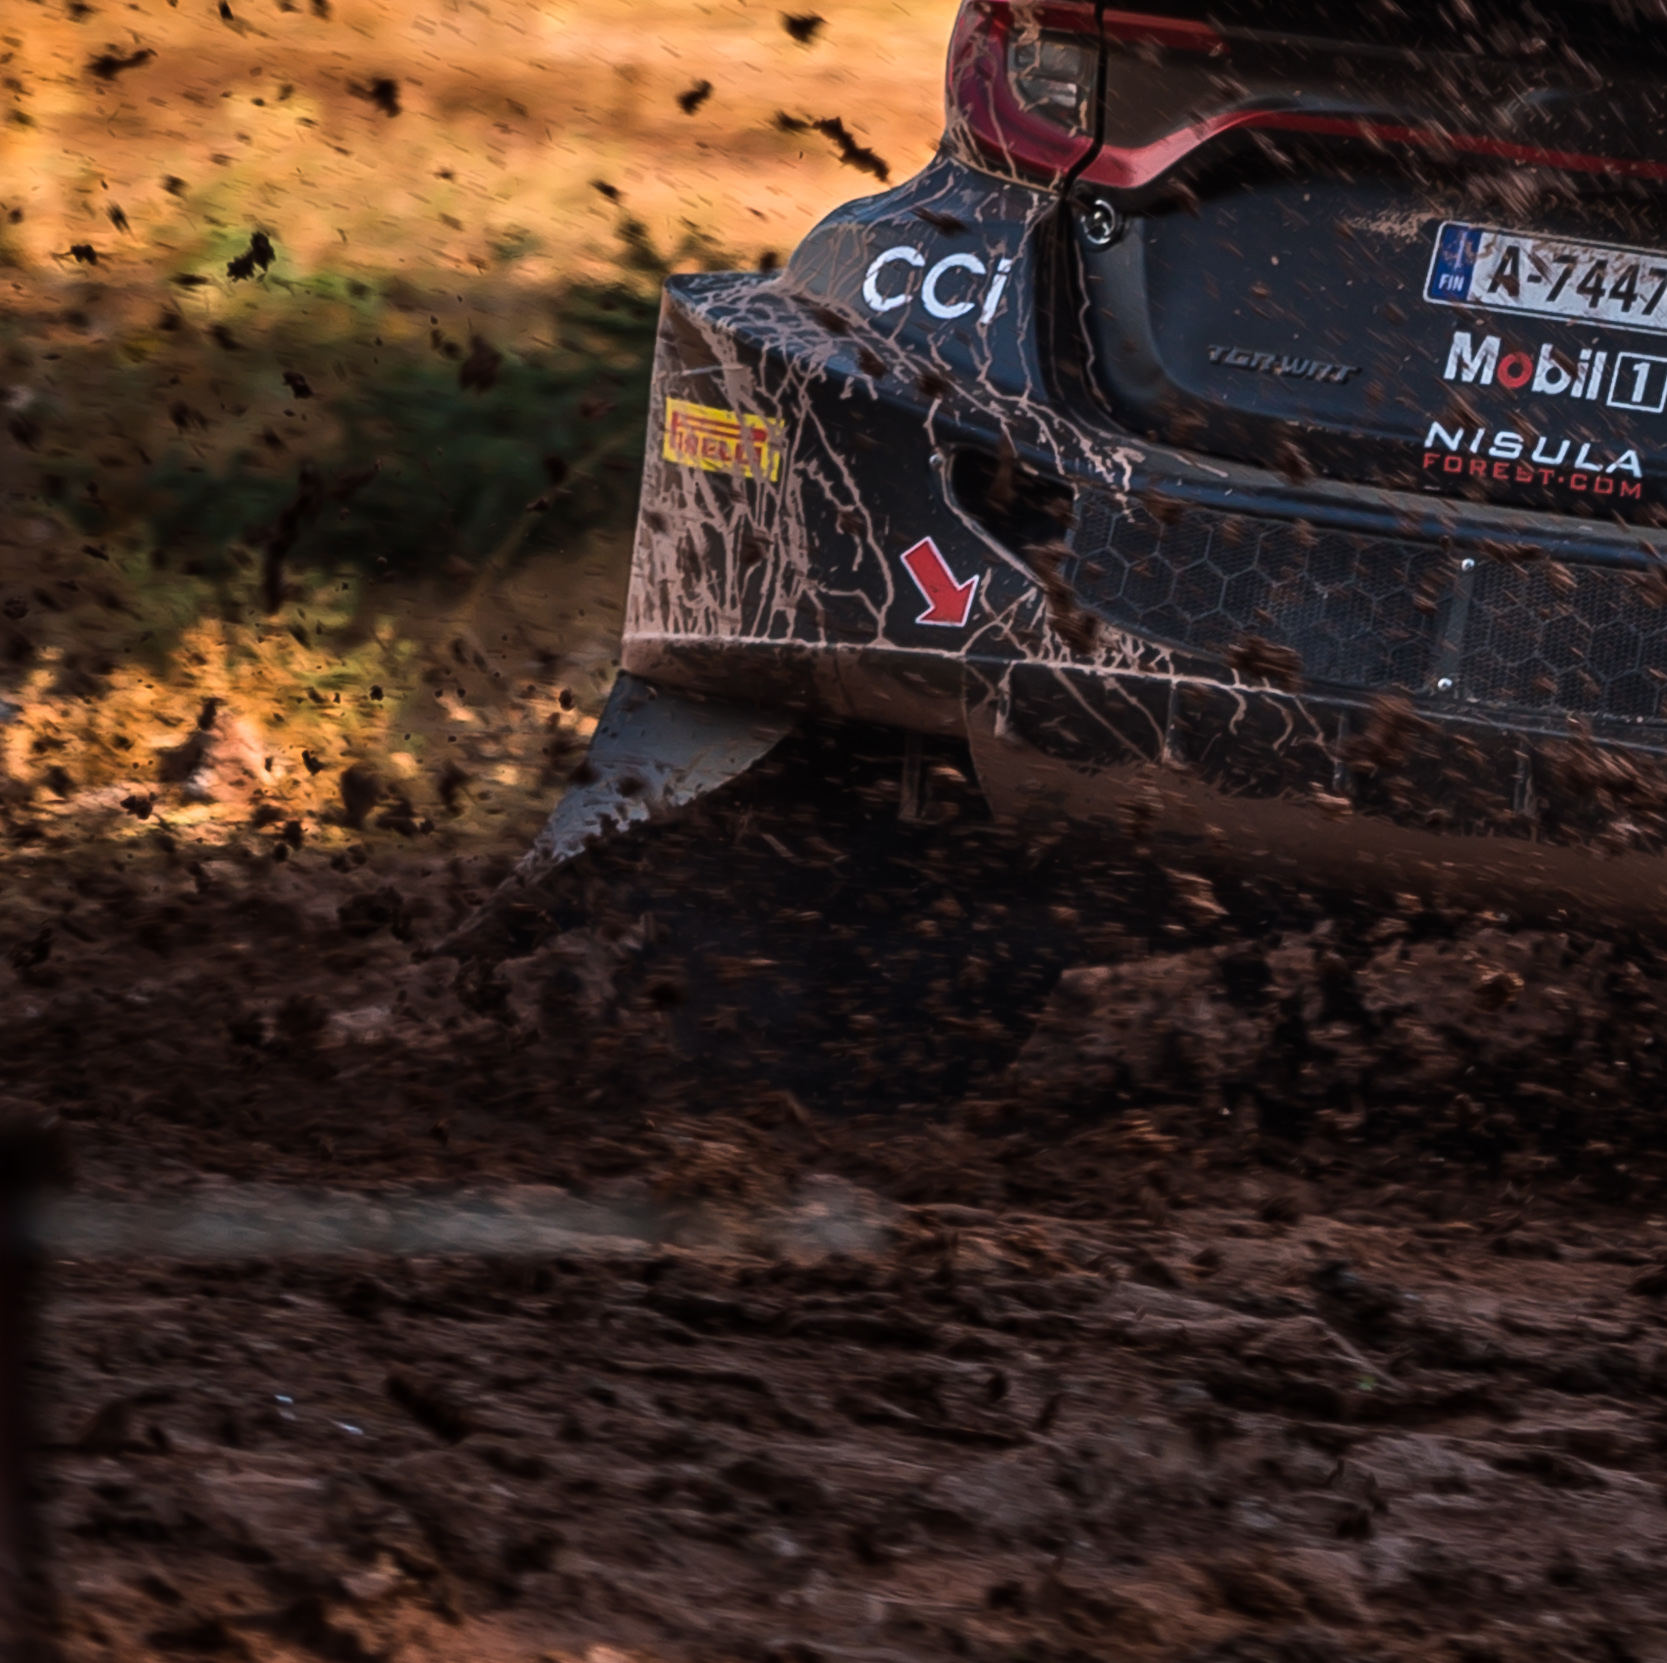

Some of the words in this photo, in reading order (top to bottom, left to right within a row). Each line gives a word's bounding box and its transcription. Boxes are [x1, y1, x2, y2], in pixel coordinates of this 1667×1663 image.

[1438, 272, 1466, 293] FIN
[1444, 331, 1607, 401] Mobil
[1424, 421, 1644, 479] NISULA
